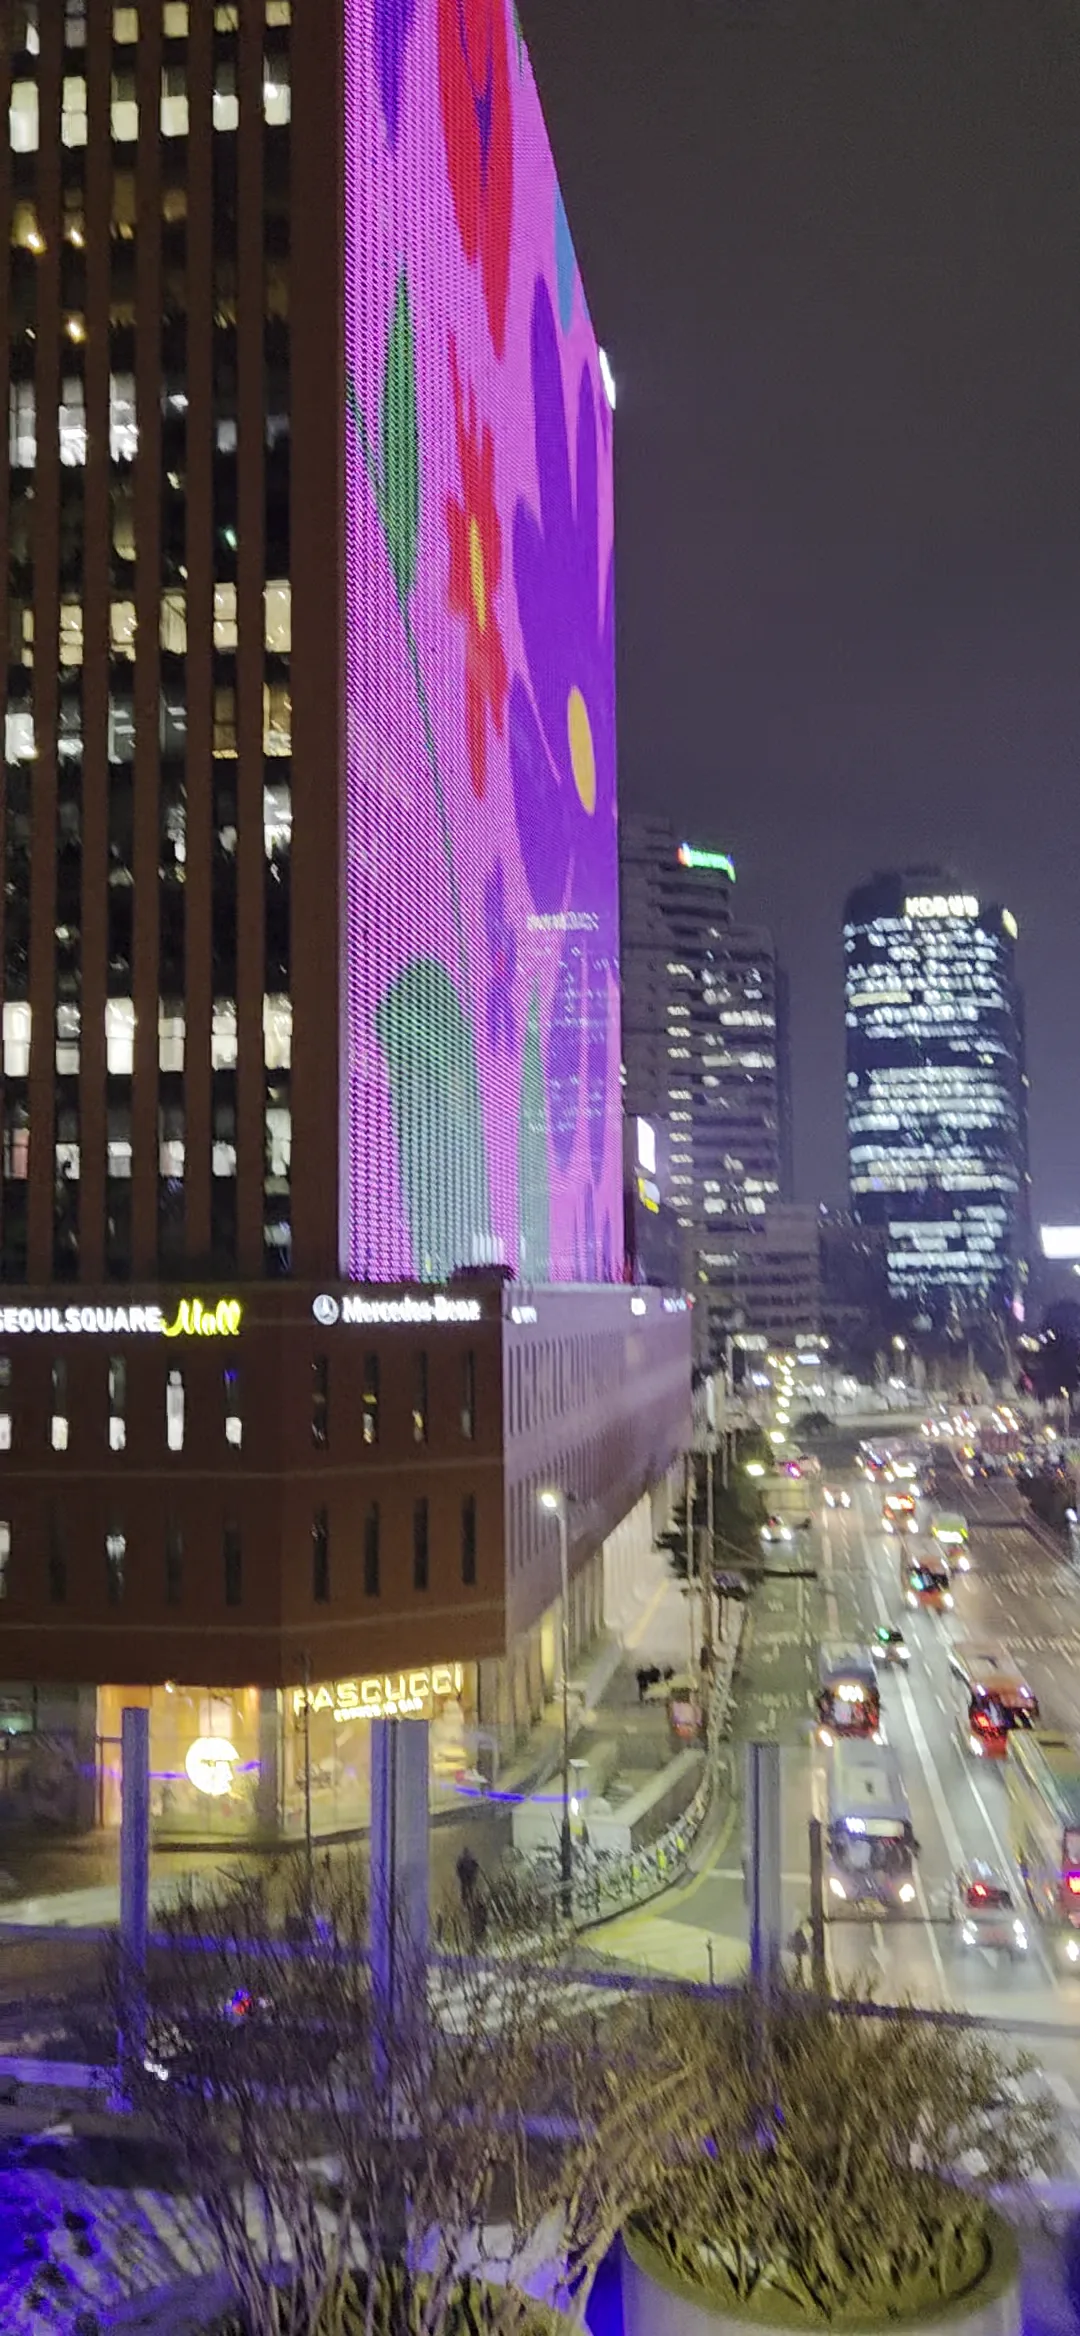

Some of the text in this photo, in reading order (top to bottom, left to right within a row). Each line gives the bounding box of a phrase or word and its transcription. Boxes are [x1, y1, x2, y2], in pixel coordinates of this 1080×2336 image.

[161, 1298, 241, 1337] Mall
[342, 1295, 481, 1323] Mercedes-Benz
[293, 1661, 463, 1717] PASCUCCI
